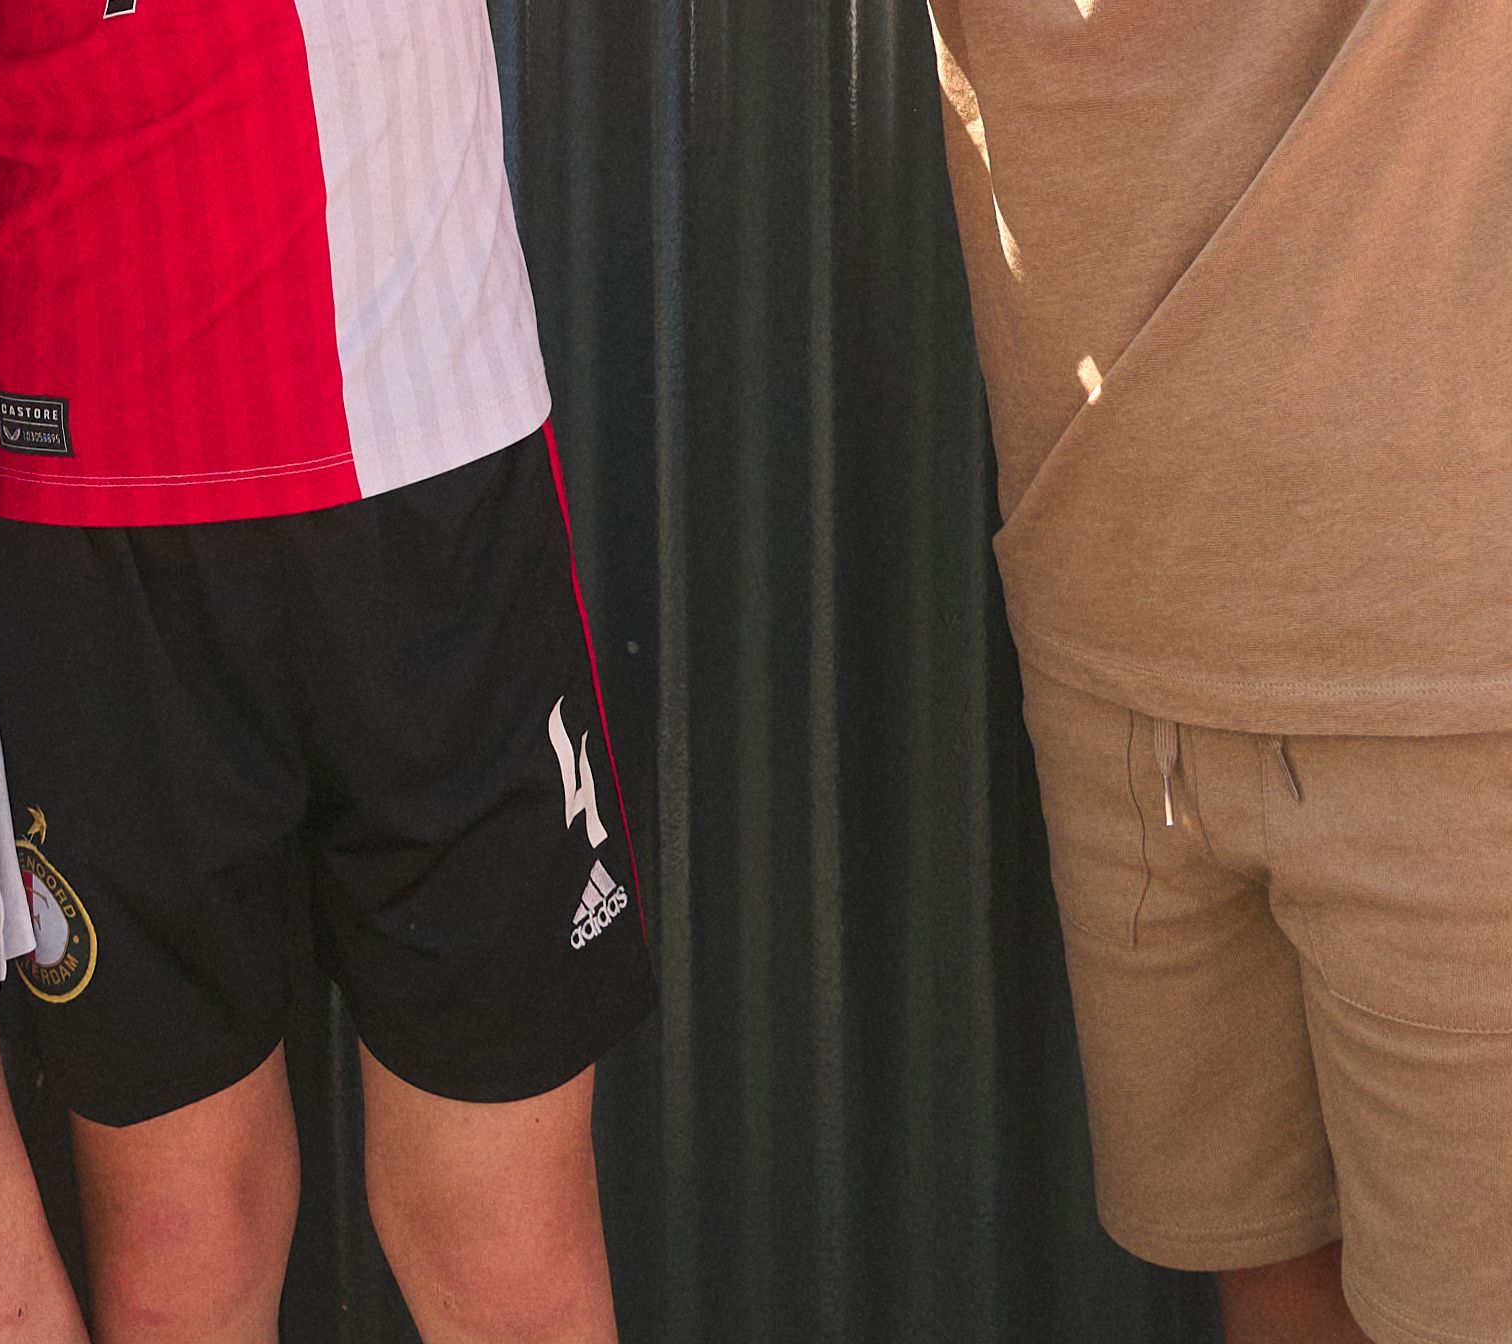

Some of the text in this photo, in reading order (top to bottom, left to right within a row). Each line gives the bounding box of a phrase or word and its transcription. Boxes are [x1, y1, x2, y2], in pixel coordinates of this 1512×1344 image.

[1, 403, 59, 421] CASTORE
[548, 695, 609, 849] 4
[570, 884, 629, 949] adidas
